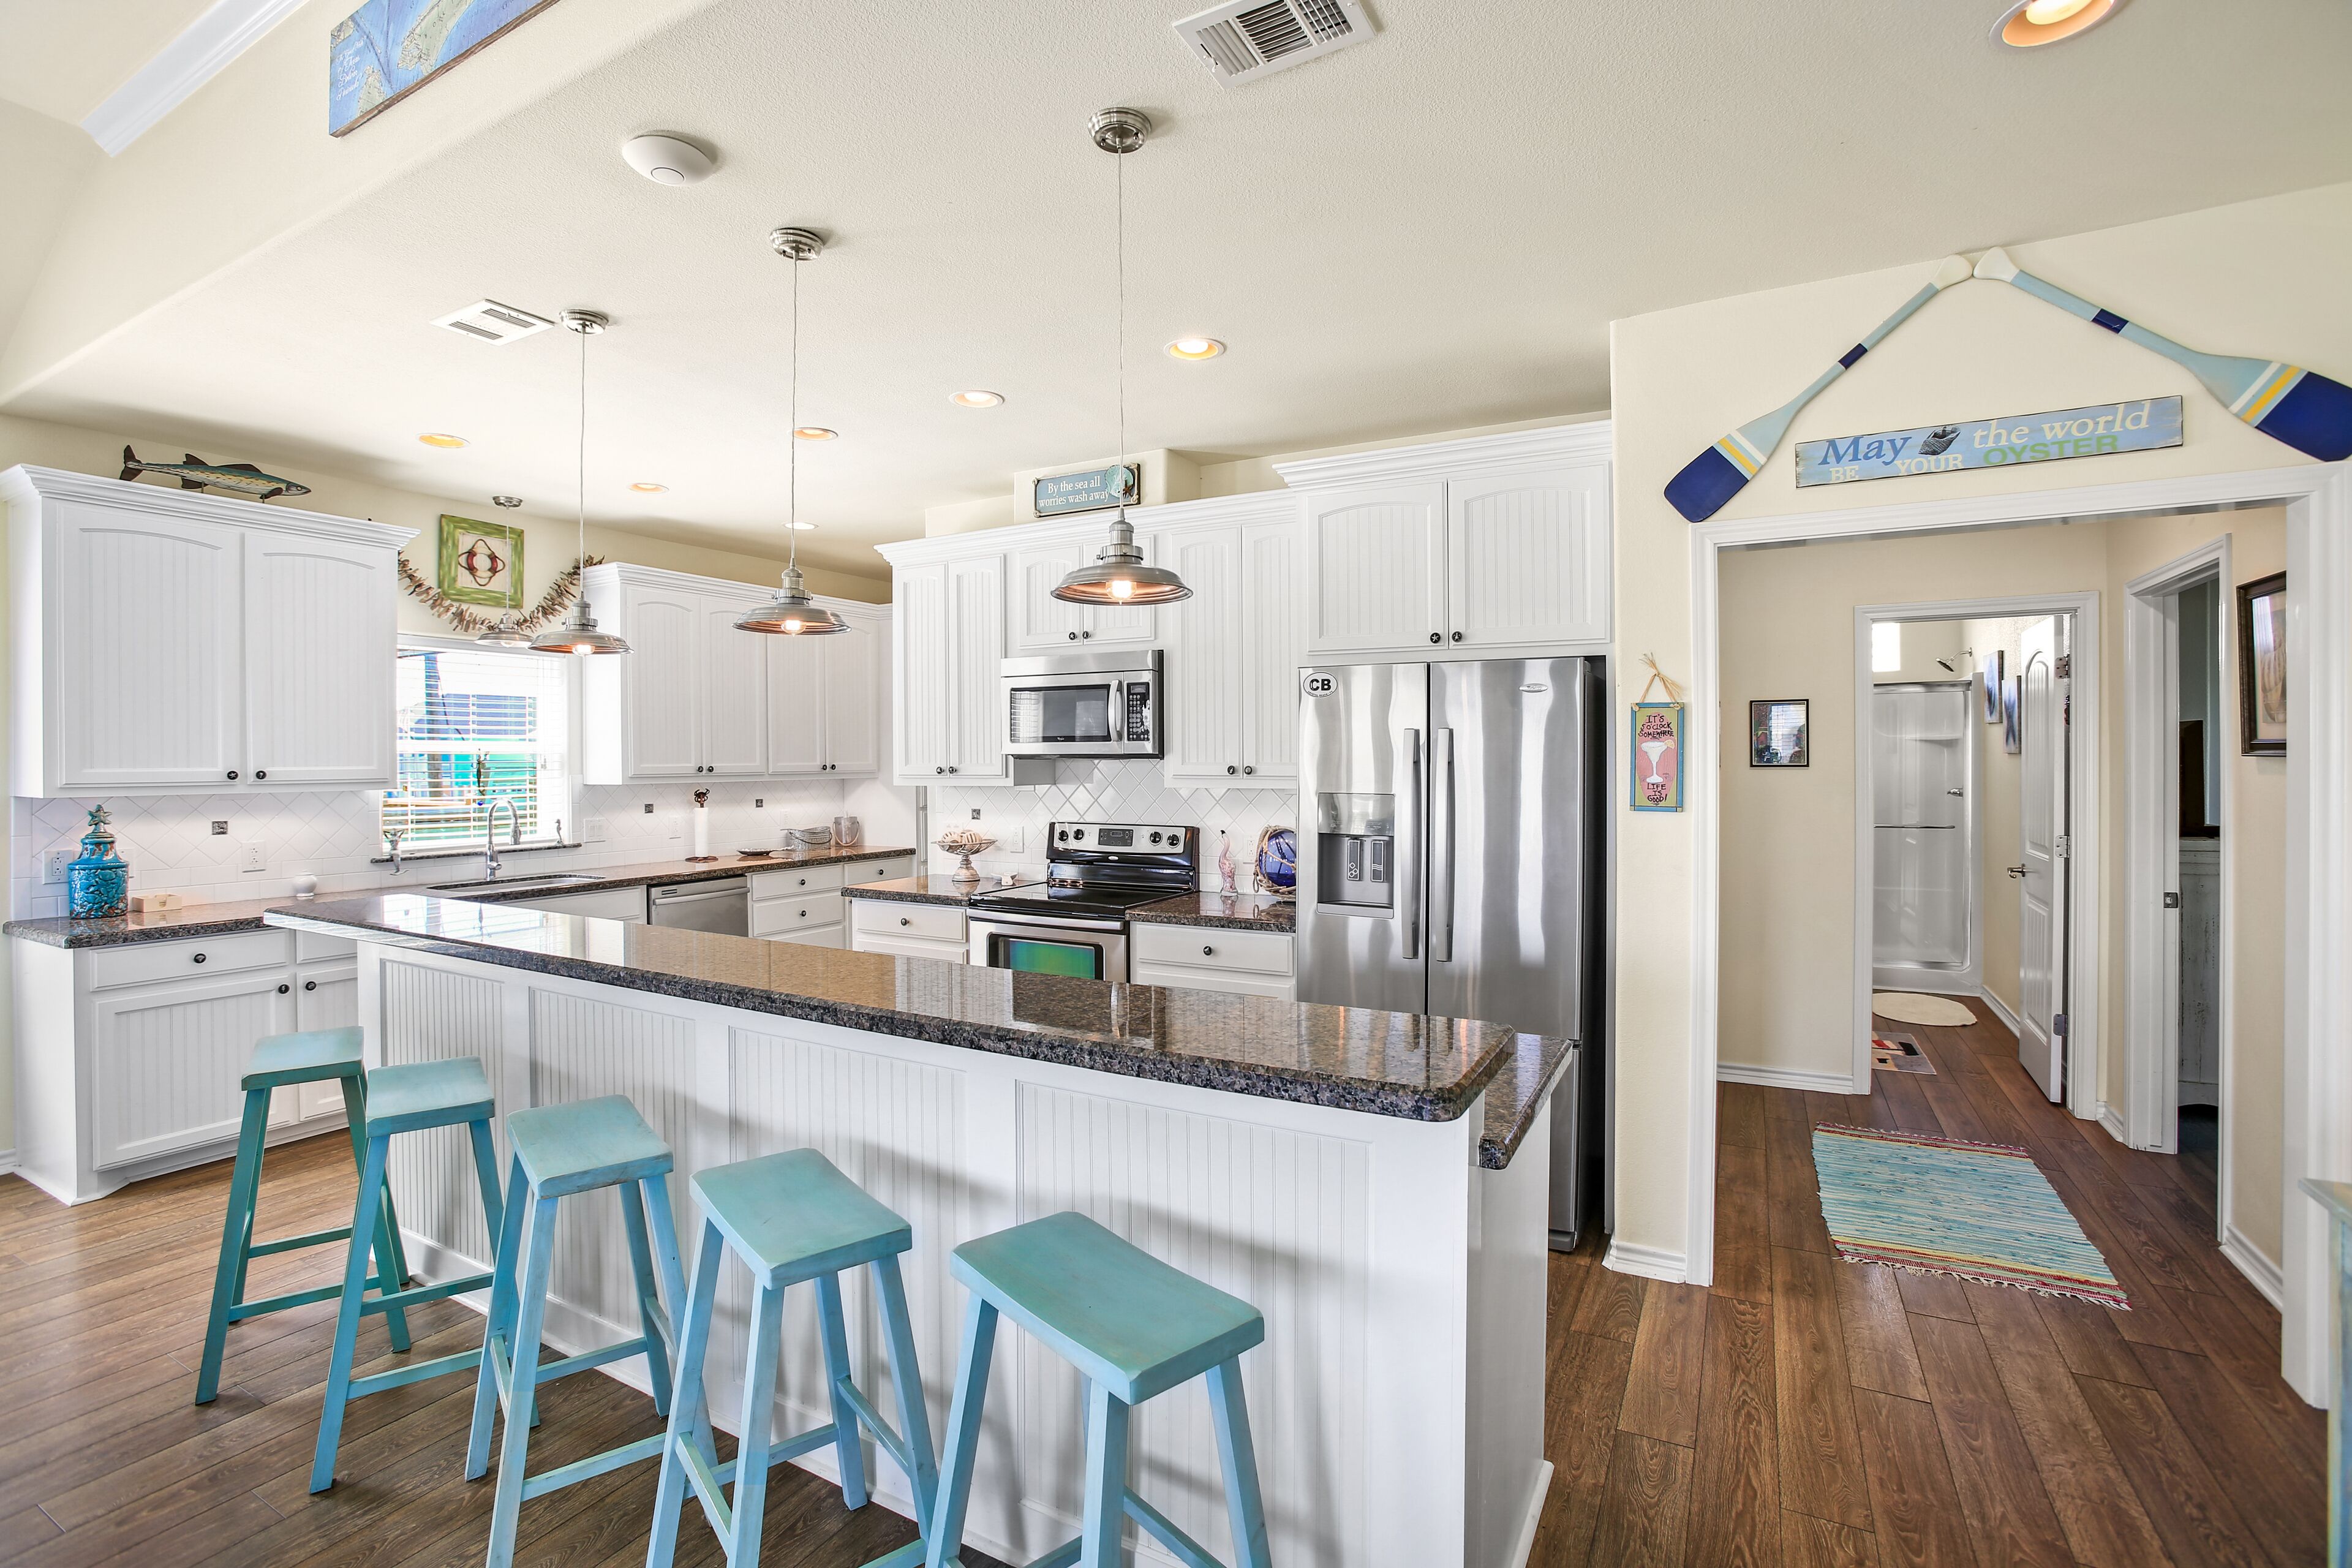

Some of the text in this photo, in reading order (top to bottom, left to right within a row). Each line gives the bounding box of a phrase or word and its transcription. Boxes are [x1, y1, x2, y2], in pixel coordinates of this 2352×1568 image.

[1818, 400, 2152, 466] May the world
[1830, 434, 2119, 483] BE YOUR OYSTER
[1048, 476, 1101, 496] By the sea all
[1039, 489, 1109, 507] worries wash away
[1309, 679, 1332, 691] CB
[1646, 714, 1665, 723] IT'S
[1646, 722, 1673, 730] O'CLOCK
[1648, 793, 1667, 803] GOOD!
